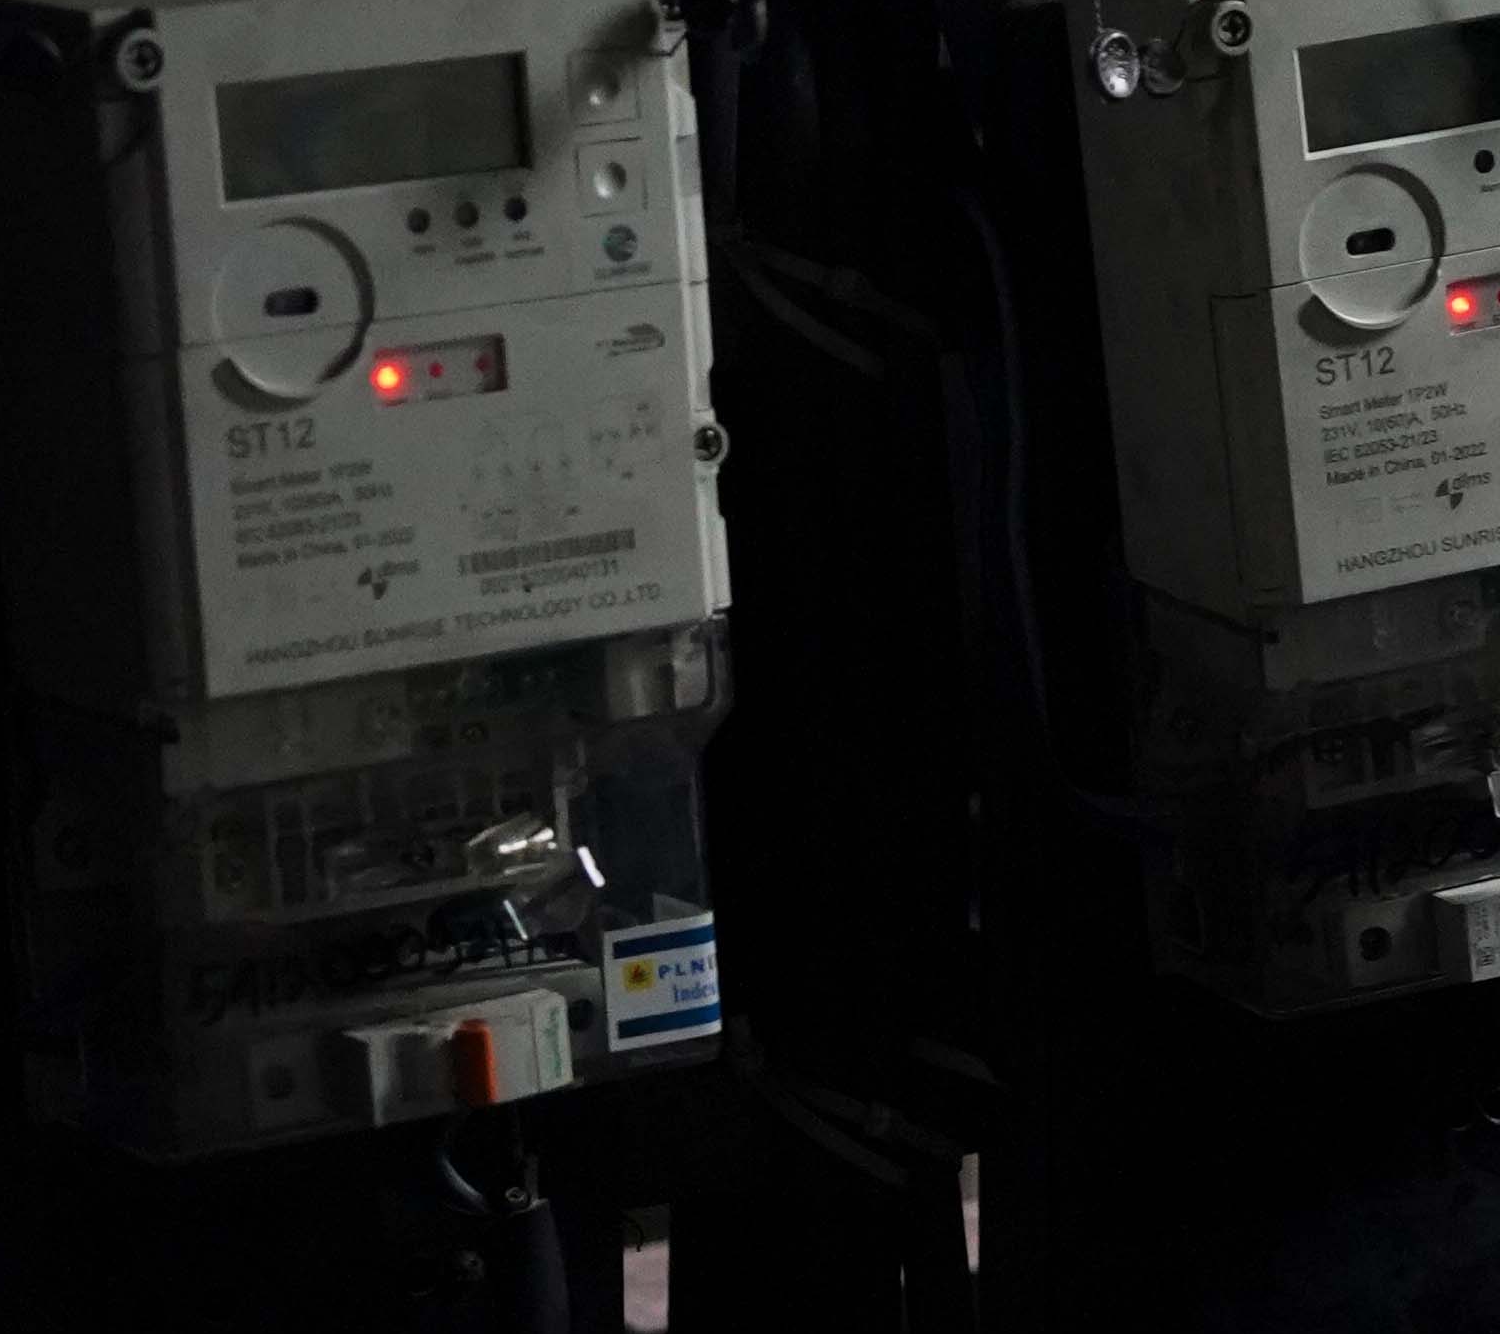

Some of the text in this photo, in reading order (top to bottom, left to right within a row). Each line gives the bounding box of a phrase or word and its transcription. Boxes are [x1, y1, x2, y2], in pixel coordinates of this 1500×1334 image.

[1316, 346, 1395, 386] ST12
[227, 418, 316, 459] ST12
[1326, 470, 1366, 486] Made
[1337, 539, 1437, 573] HANGZHOU
[453, 593, 583, 631] TECHNOLOGY
[658, 958, 705, 980] PLN
